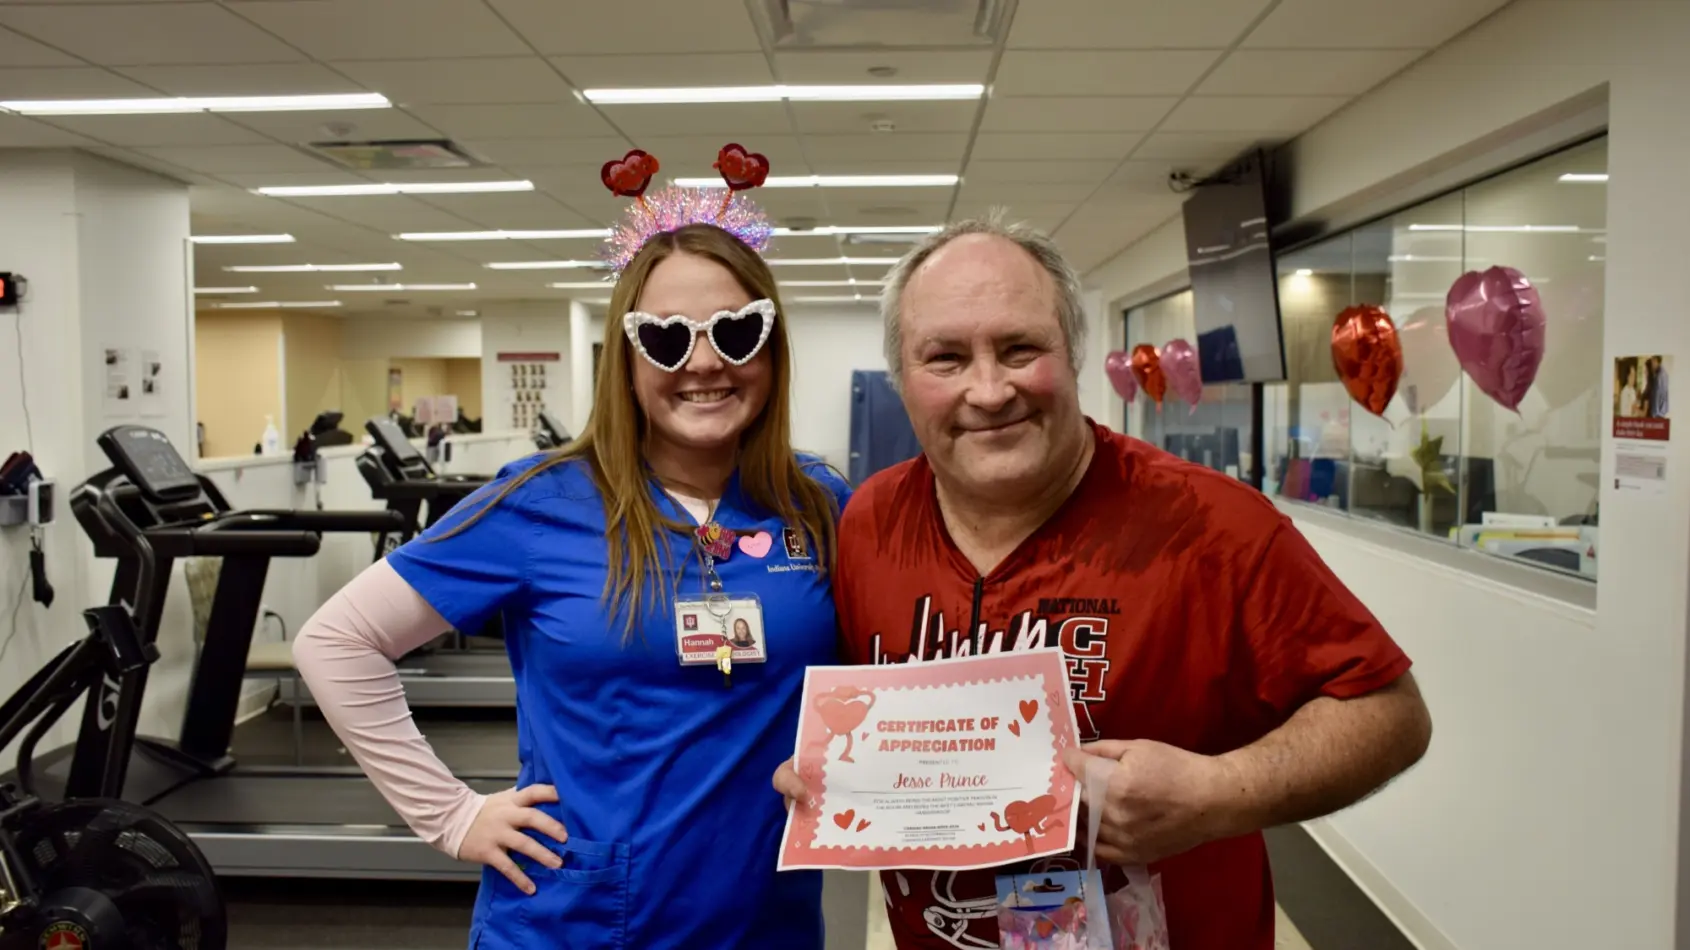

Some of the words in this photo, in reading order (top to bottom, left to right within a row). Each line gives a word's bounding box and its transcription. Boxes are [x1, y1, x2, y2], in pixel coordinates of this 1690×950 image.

[767, 565, 790, 573] Indiana
[1037, 598, 1120, 614] NATIONAL
[684, 638, 714, 647] Hannah
[877, 719, 975, 733] CERTIFICATE
[980, 717, 999, 730] OF
[878, 738, 996, 752] APPRECIATION
[893, 772, 934, 789] Jesse
[940, 771, 989, 789] Prince
